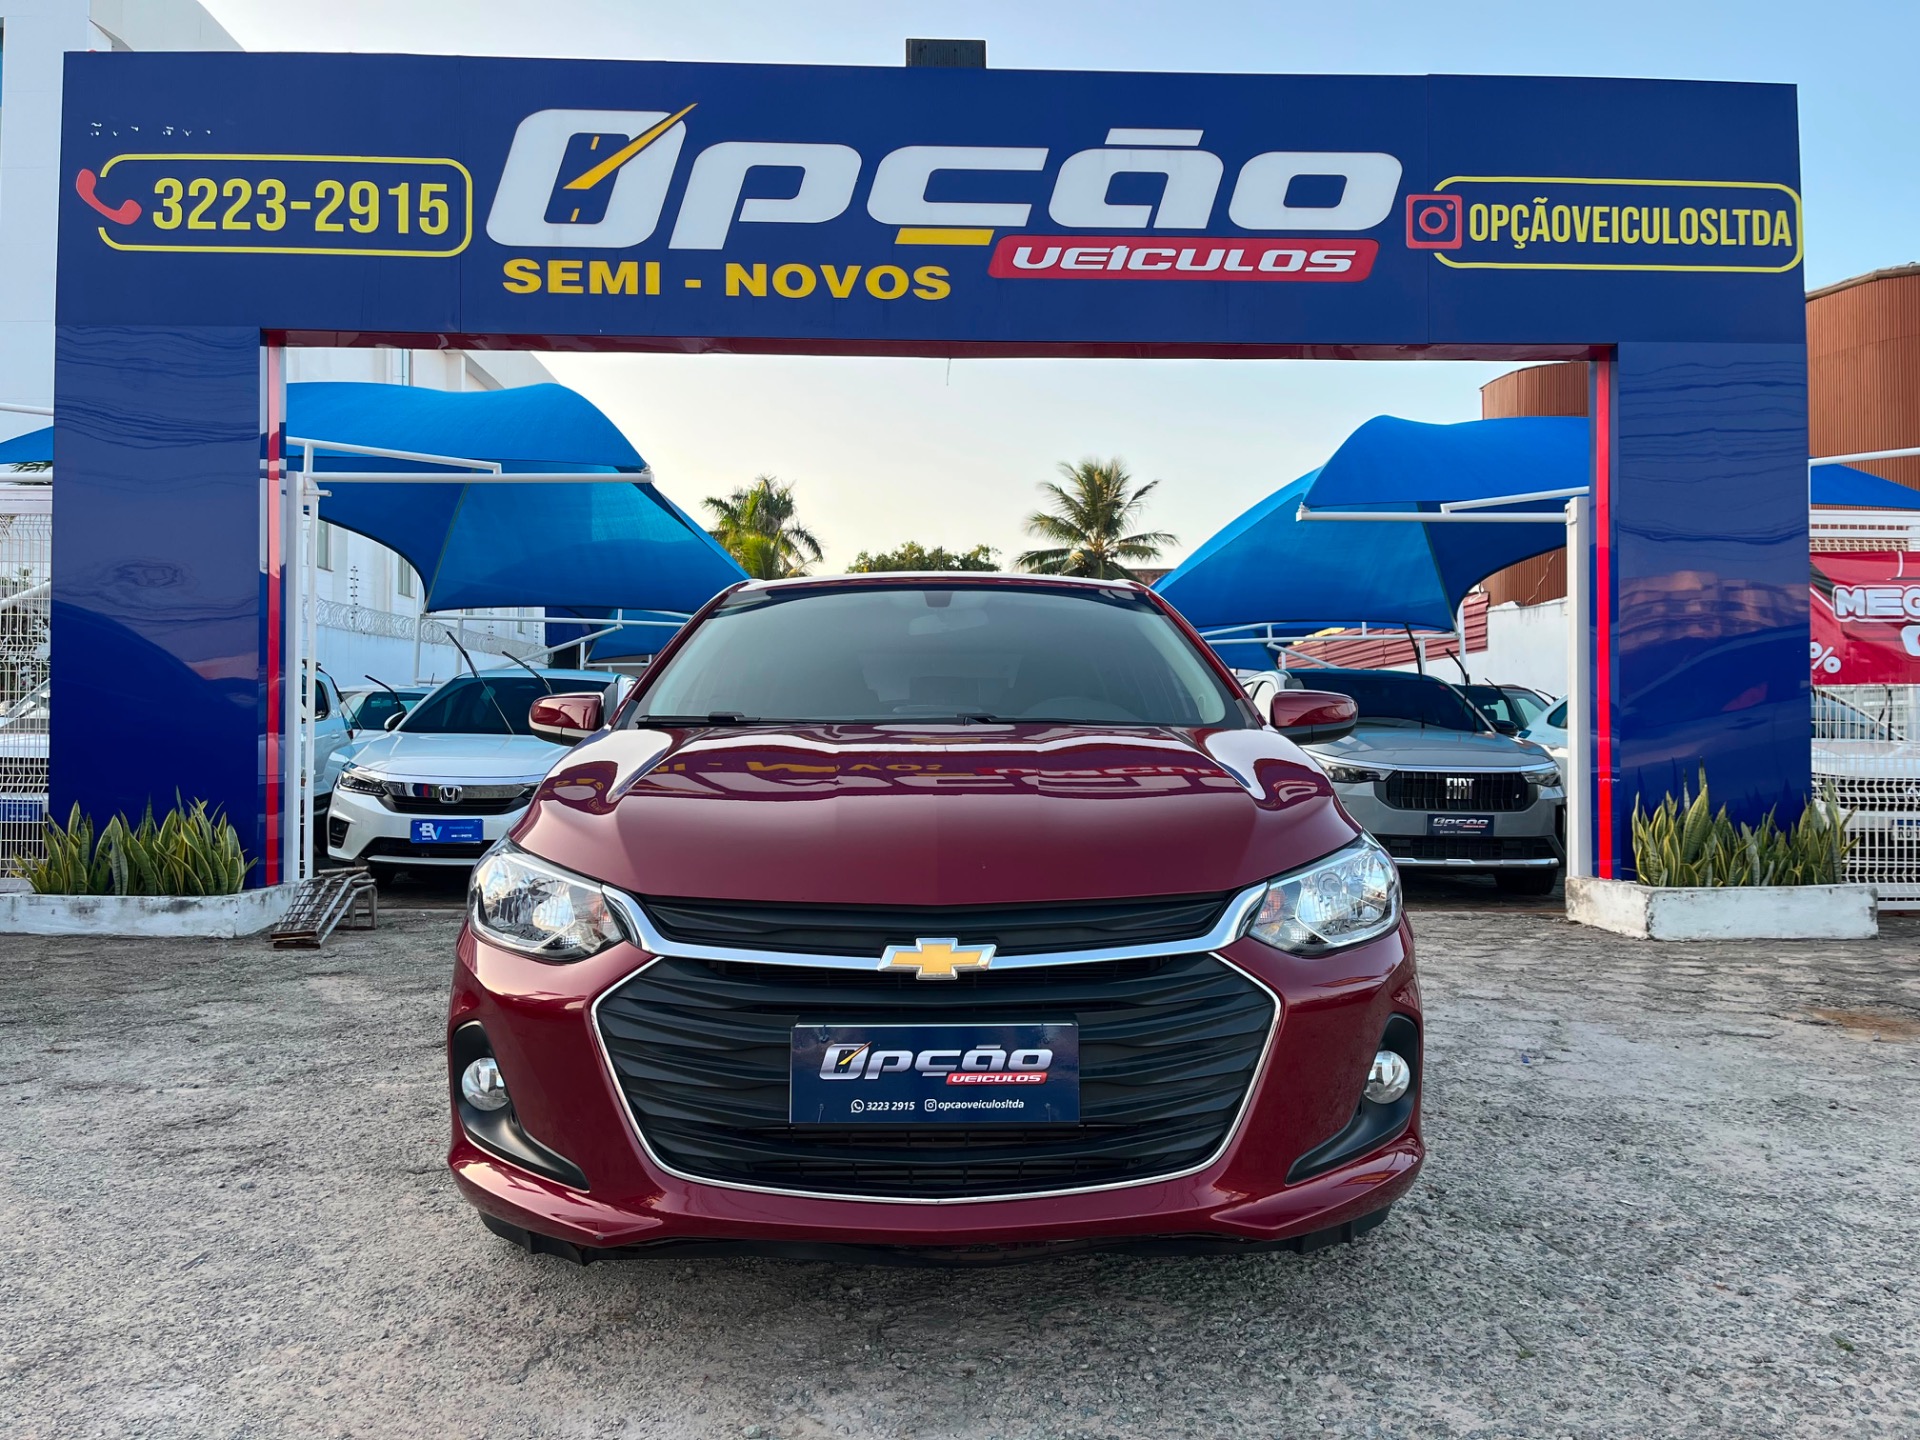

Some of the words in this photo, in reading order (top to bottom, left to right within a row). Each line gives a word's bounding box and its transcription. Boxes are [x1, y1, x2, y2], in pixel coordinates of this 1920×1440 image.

[153, 177, 450, 236] 3223-2915
[1468, 196, 1794, 249] OPÇÃOVEICULOSLTDA
[502, 258, 662, 296] SEMI
[724, 263, 953, 301] NOVOS
[1446, 777, 1475, 800] FIAT
[866, 1100, 889, 1111] 3223
[891, 1100, 916, 1111] 2915
[937, 1098, 1025, 1111] opcaoveiculosltda
